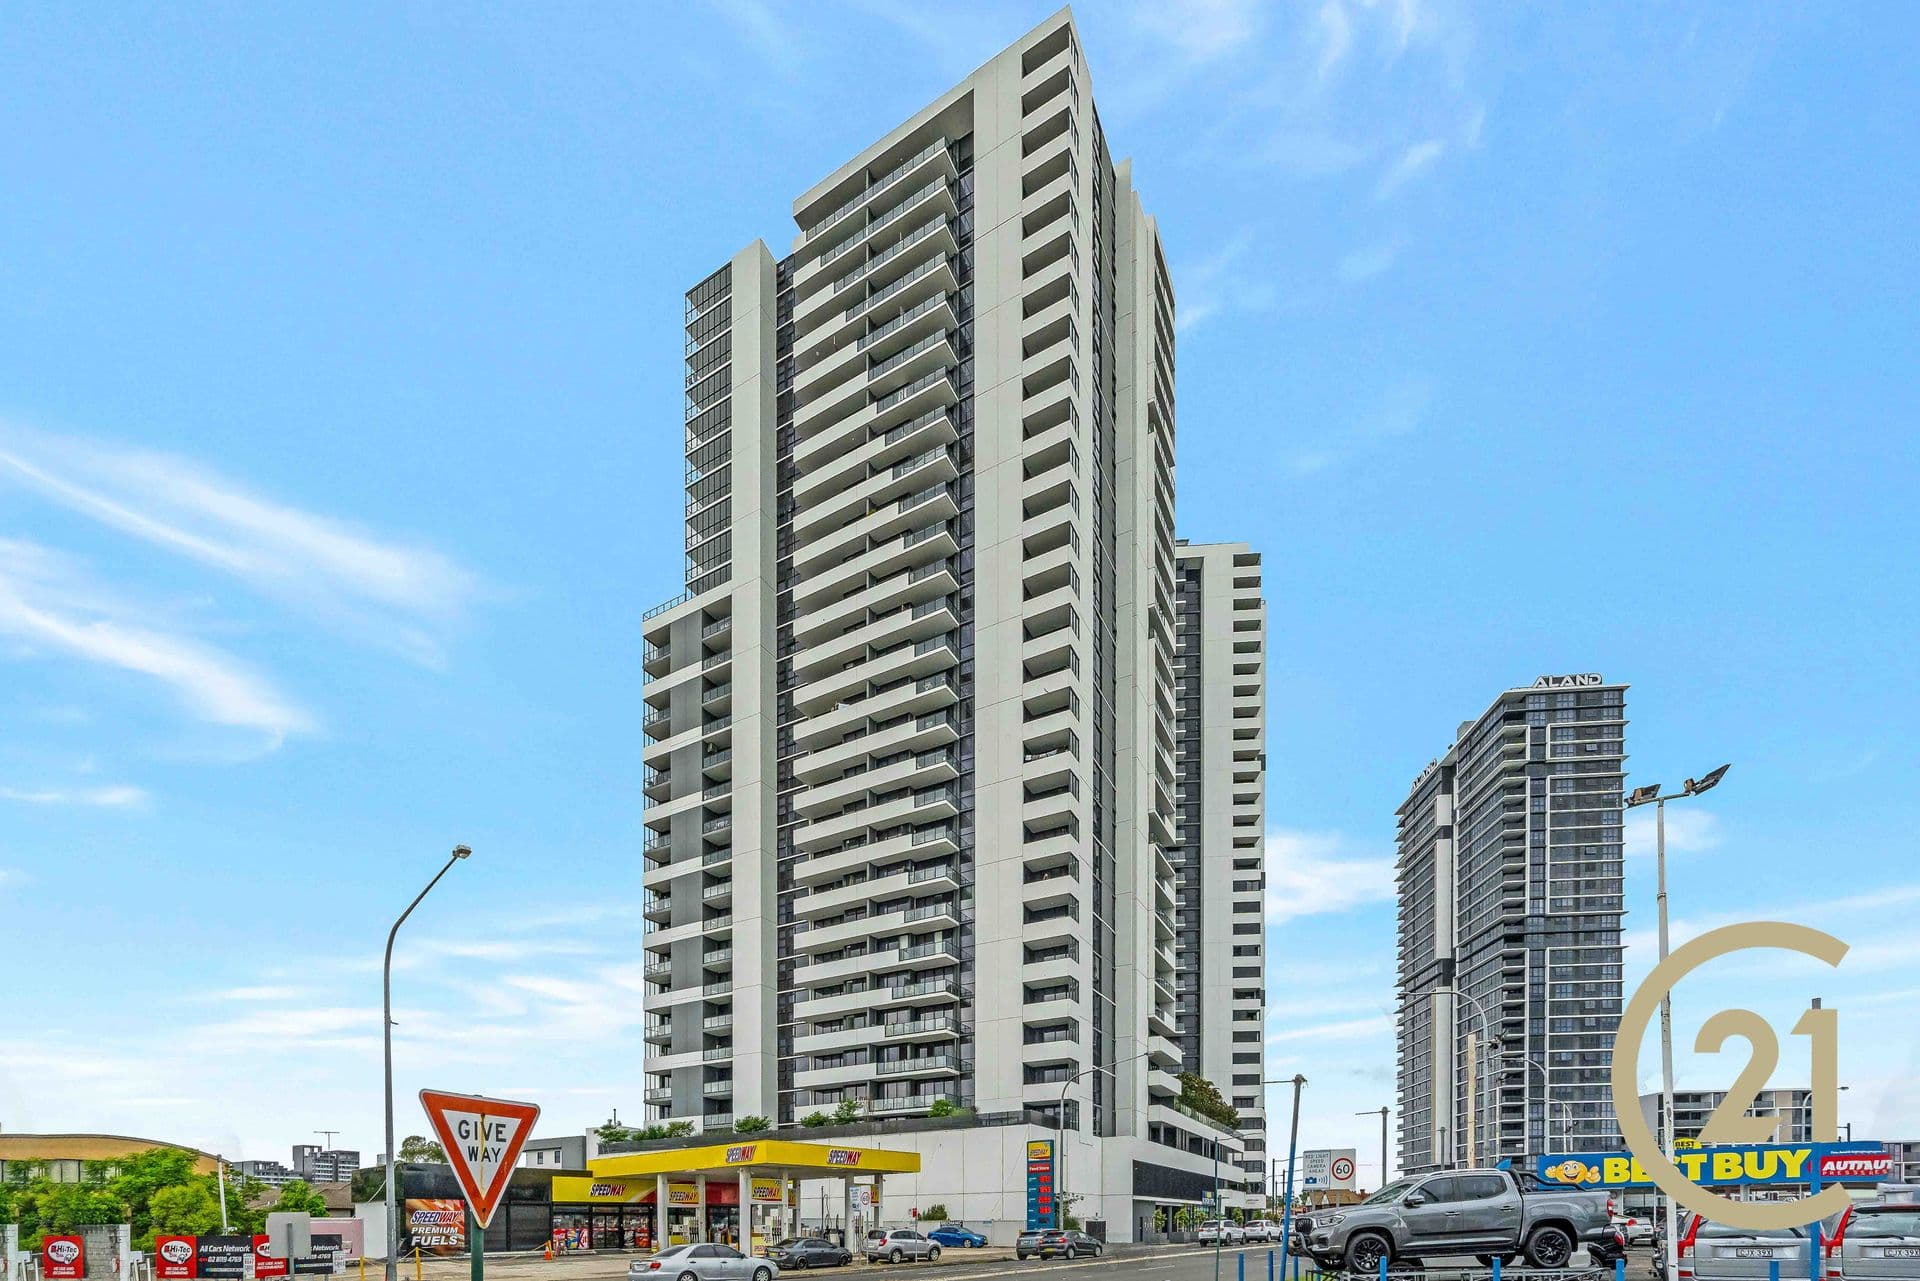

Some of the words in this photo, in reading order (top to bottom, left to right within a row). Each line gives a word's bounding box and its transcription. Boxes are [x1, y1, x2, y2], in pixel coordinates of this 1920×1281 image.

[1533, 673, 1602, 688] ALAND
[458, 1119, 507, 1143] GIVE
[467, 1145, 501, 1163] WAY
[725, 1144, 757, 1163] SPEEDWAY
[827, 1149, 862, 1165] SPEEDWAY
[1335, 1163, 1350, 1175] 60
[1603, 1153, 1708, 1184] BET
[1712, 1149, 1812, 1181] BUY
[590, 1184, 626, 1197] SPEEDWAY
[669, 1191, 697, 1201] SPEEDWAY
[752, 1186, 780, 1198] SPEEDWAY
[411, 1210, 459, 1224] SPEEDWAY
[411, 1227, 458, 1235] PREMIUM
[411, 1236, 458, 1247] FUELS
[57, 1245, 77, 1253] Hi-Tec
[170, 1245, 191, 1253] Hi-Tec
[222, 1244, 251, 1252] Network
